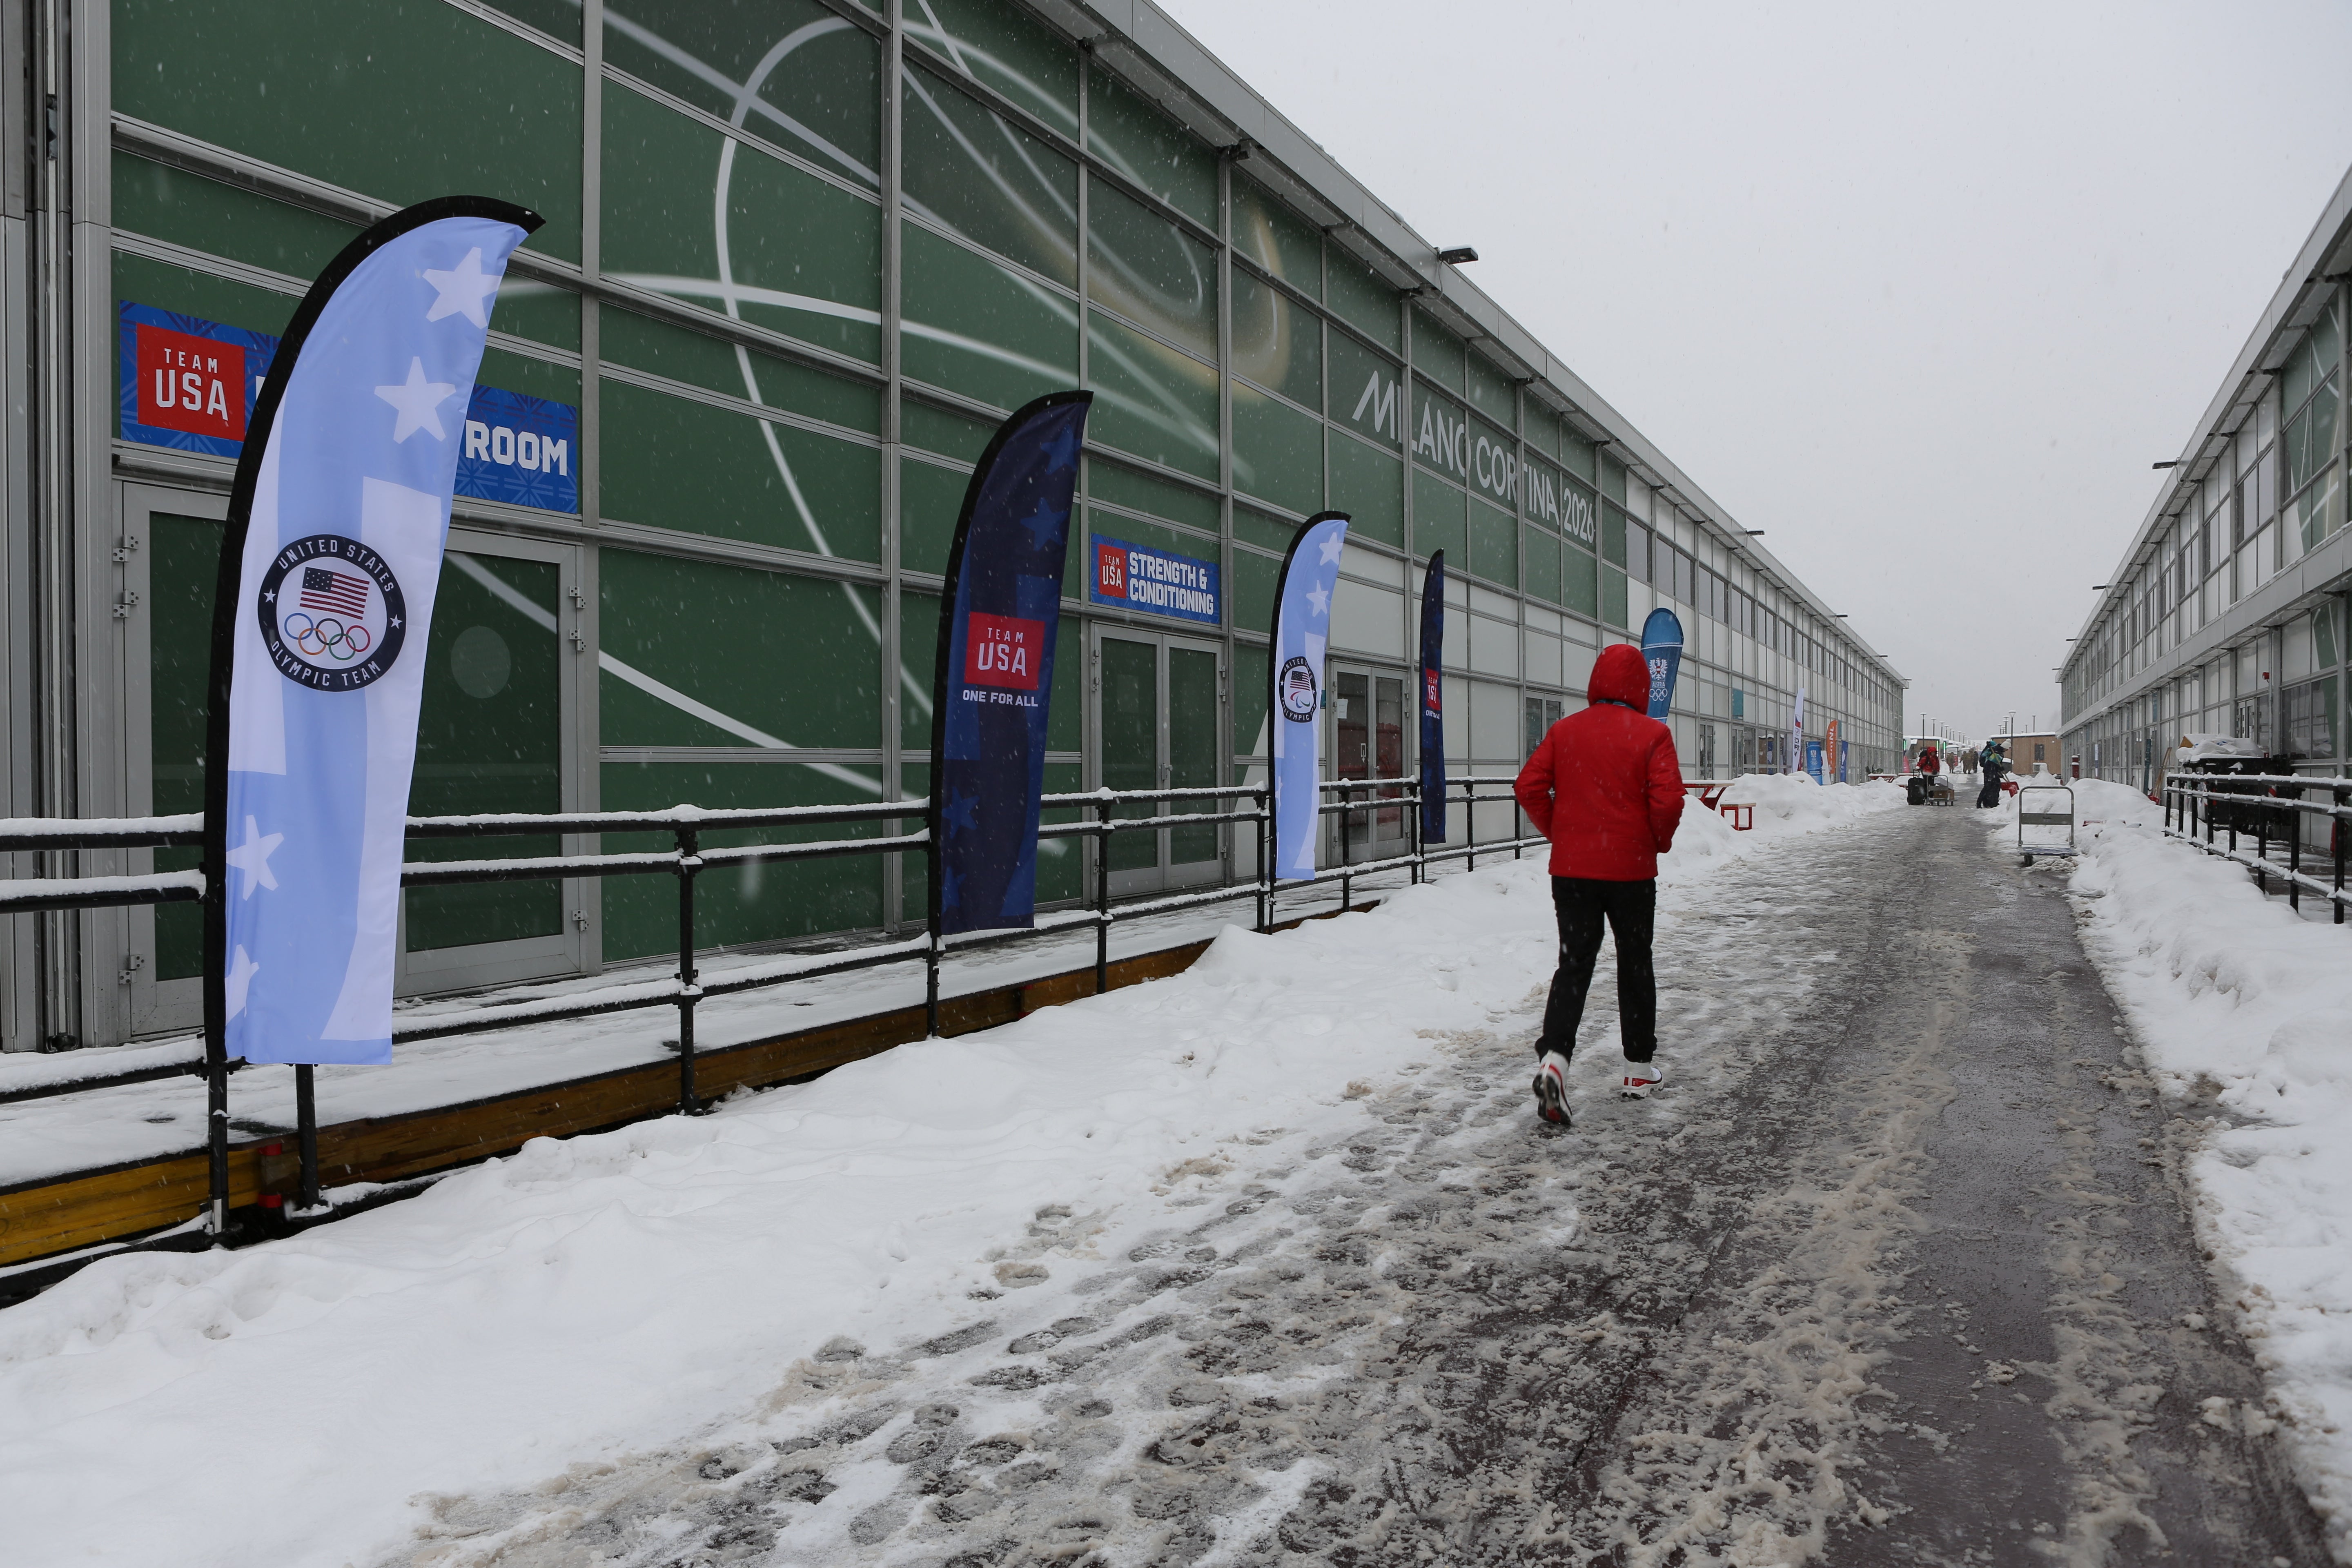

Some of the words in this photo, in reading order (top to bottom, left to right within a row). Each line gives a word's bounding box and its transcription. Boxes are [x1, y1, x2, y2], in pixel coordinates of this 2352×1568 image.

[164, 348, 217, 373] TEAM
[156, 369, 228, 421] USA
[466, 419, 567, 477] ROOM
[1352, 370, 1471, 477] MIANO
[1476, 436, 1560, 526] CORINA
[1564, 488, 1594, 543] 2026
[278, 540, 338, 569] UNITED
[347, 545, 394, 592] STATES
[1103, 565, 1122, 589] USA
[1105, 555, 1119, 566] TEAM
[1129, 552, 1196, 588] STRENGTH
[1199, 568, 1207, 590] &
[1130, 578, 1214, 615] CONDITIONING
[988, 627, 1023, 643] TEAM
[272, 641, 330, 686] OLYMPIC
[342, 661, 381, 686] TEAM
[978, 642, 1026, 676] USA
[1284, 658, 1303, 672] UNITED
[963, 690, 987, 702] ONE
[990, 692, 1013, 705] FOR
[1015, 695, 1038, 707] ALL
